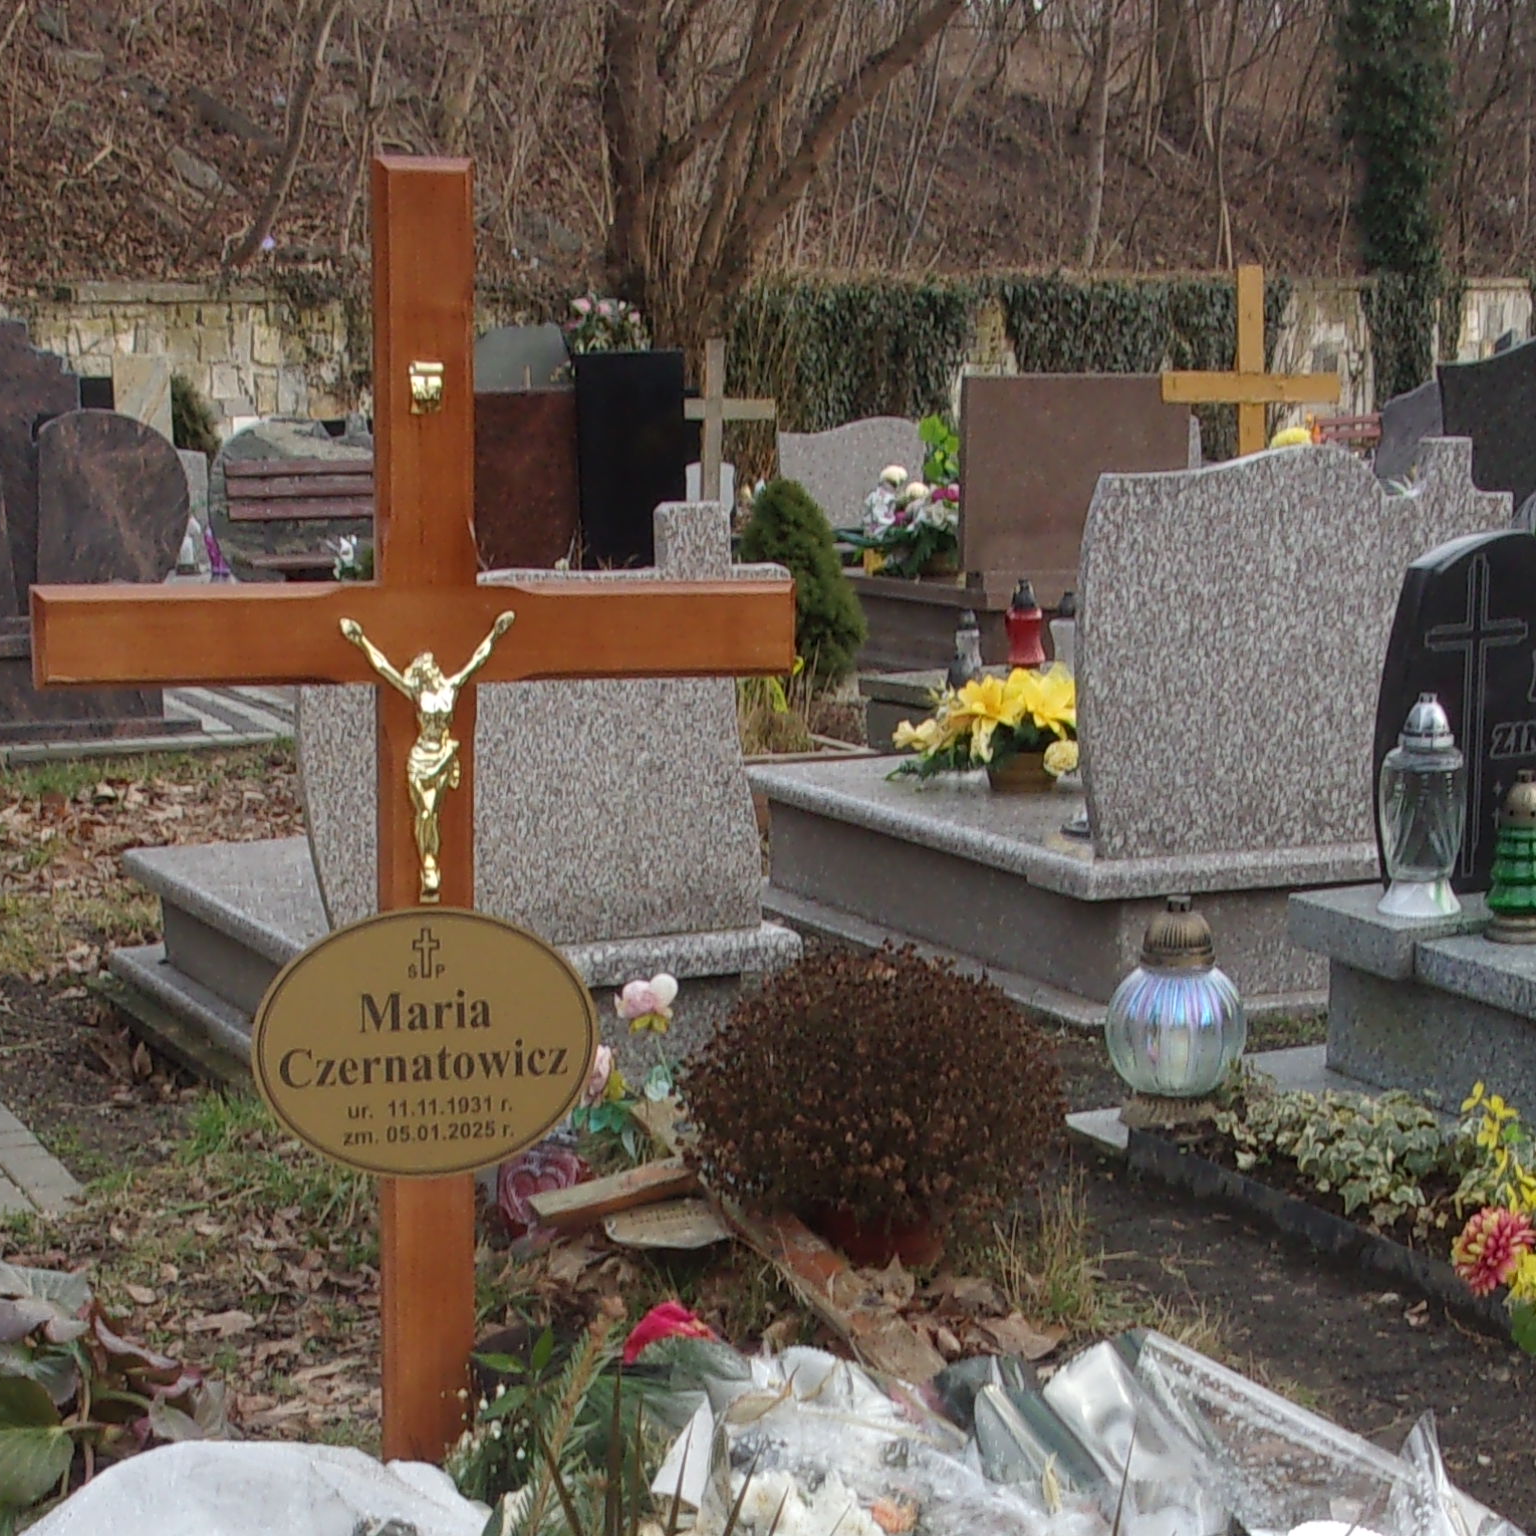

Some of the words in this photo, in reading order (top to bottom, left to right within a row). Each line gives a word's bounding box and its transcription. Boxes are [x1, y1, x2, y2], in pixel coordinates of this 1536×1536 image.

[360, 989, 491, 1034] Maria
[280, 1039, 568, 1089] Czernatowicz
[348, 1104, 374, 1121] ur.
[387, 1096, 493, 1118] 11.11.1931
[500, 1099, 512, 1114] r.
[343, 1130, 380, 1146] zm.
[386, 1121, 496, 1144] 05.01.2025
[502, 1124, 514, 1139] r.
